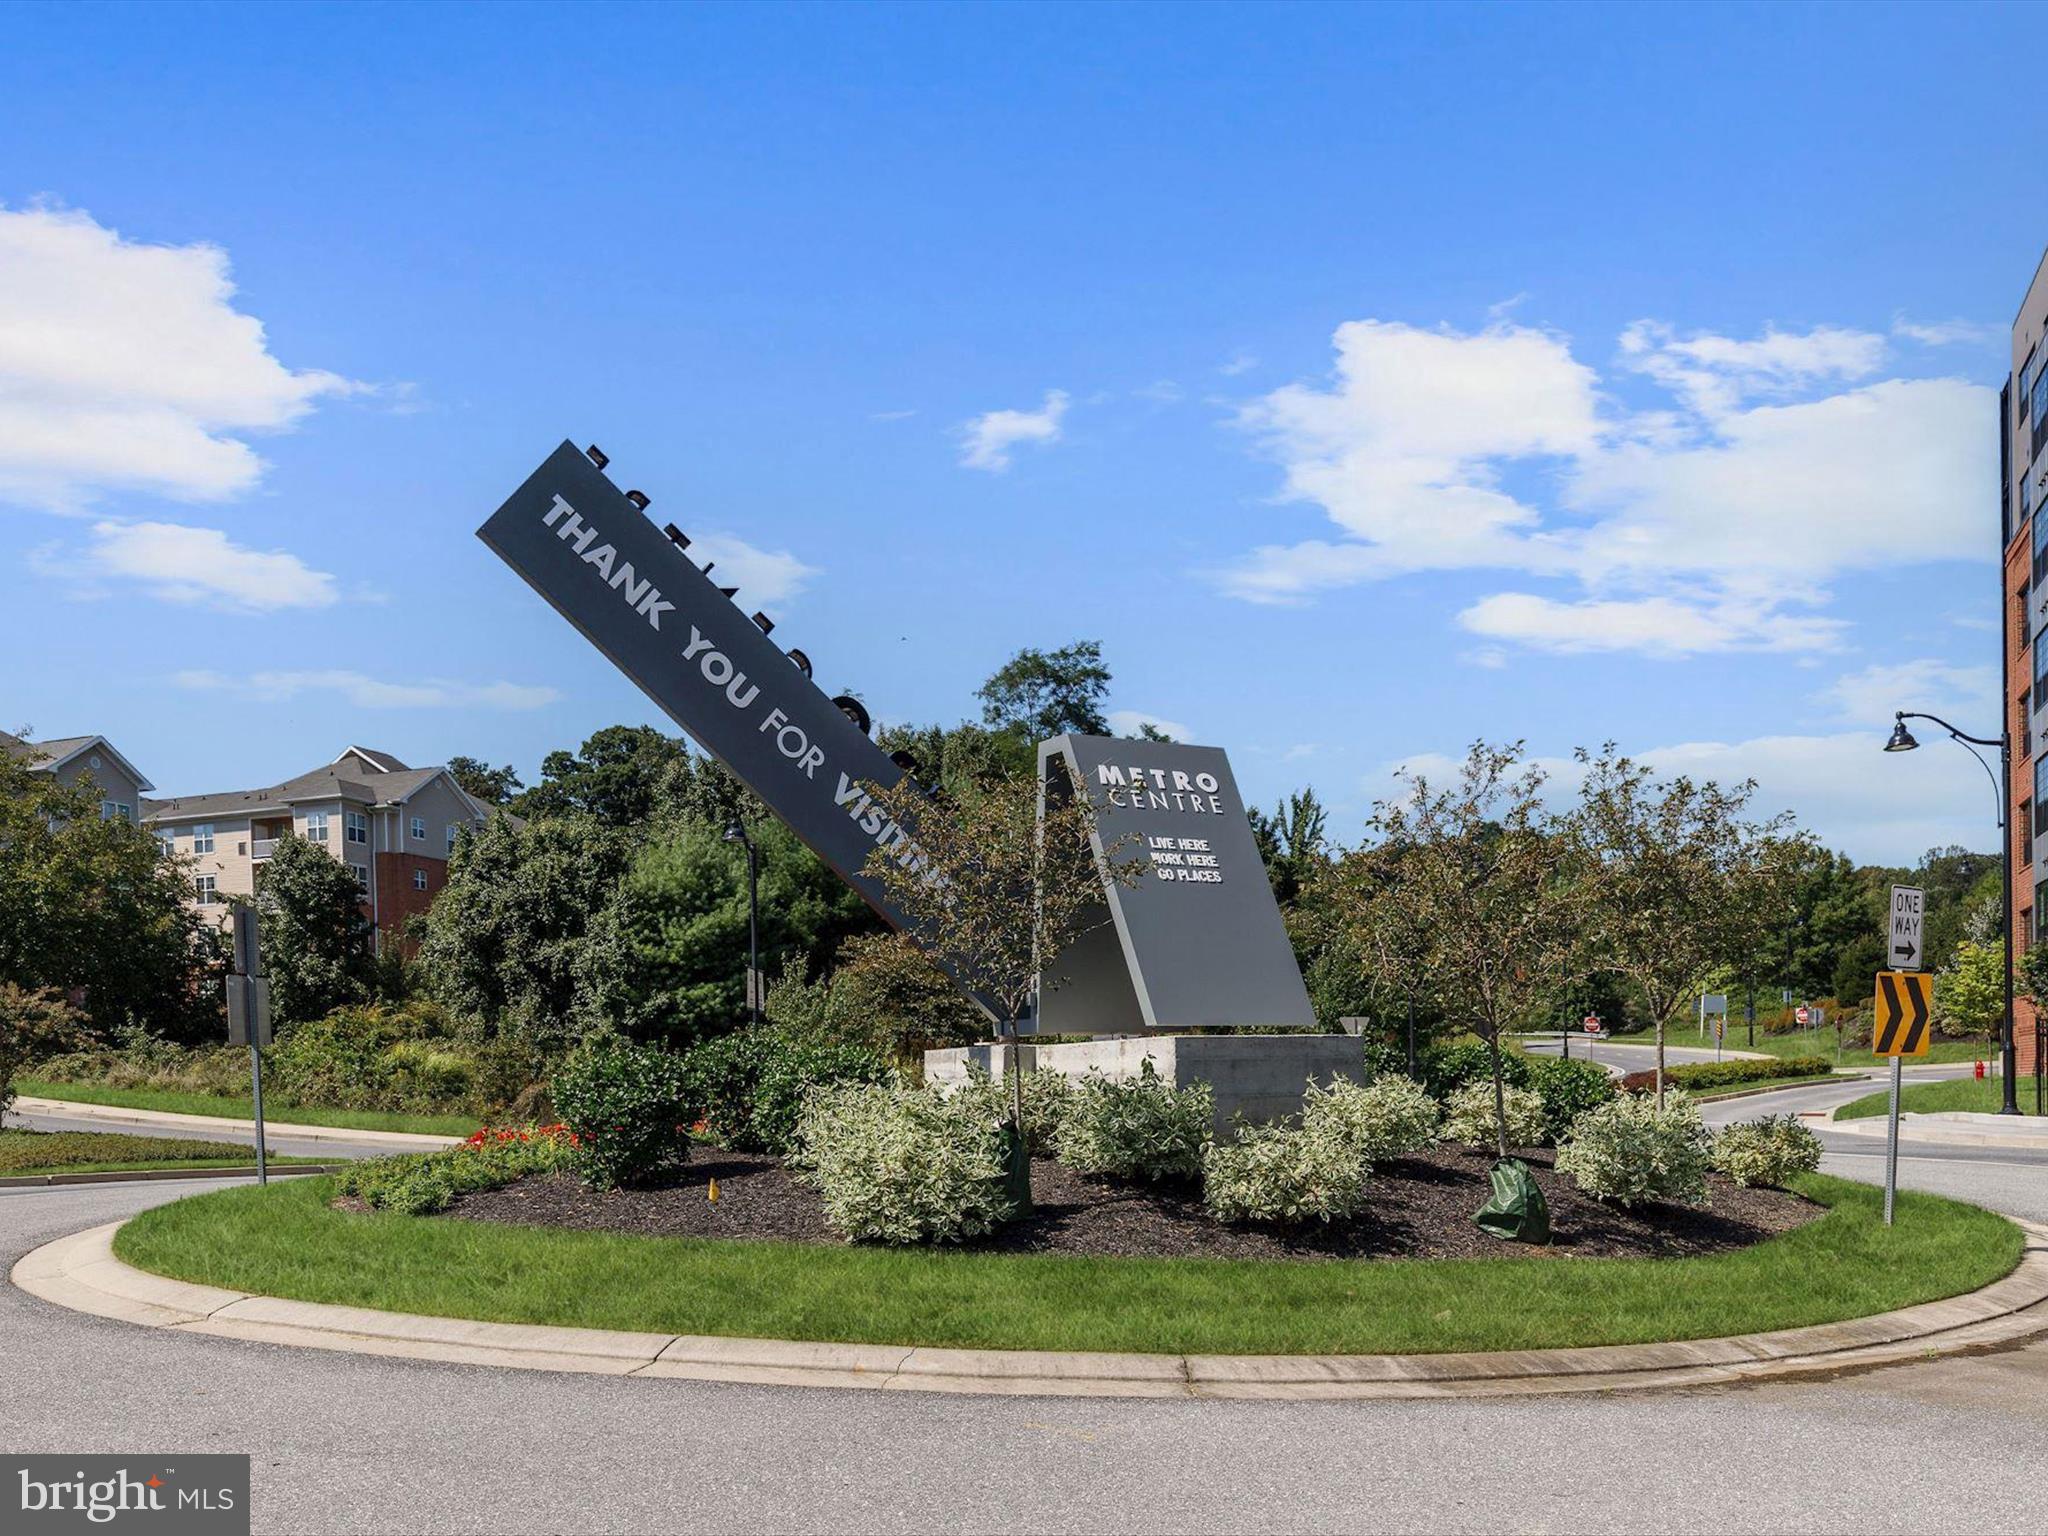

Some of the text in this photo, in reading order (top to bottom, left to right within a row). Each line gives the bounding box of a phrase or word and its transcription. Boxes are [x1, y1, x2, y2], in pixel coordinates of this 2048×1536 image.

[541, 493, 676, 632] THANK
[681, 625, 761, 709] YOU
[759, 707, 825, 780] FOR
[1098, 764, 1219, 793] METRO
[1108, 788, 1224, 814] CENTRE
[1148, 836, 1211, 852] LIVE HERE
[1150, 852, 1219, 867] WORK HERE
[1158, 868, 1222, 882] GO PLACES
[1896, 893, 1920, 913] ONE
[1895, 916, 1920, 936] WAY
